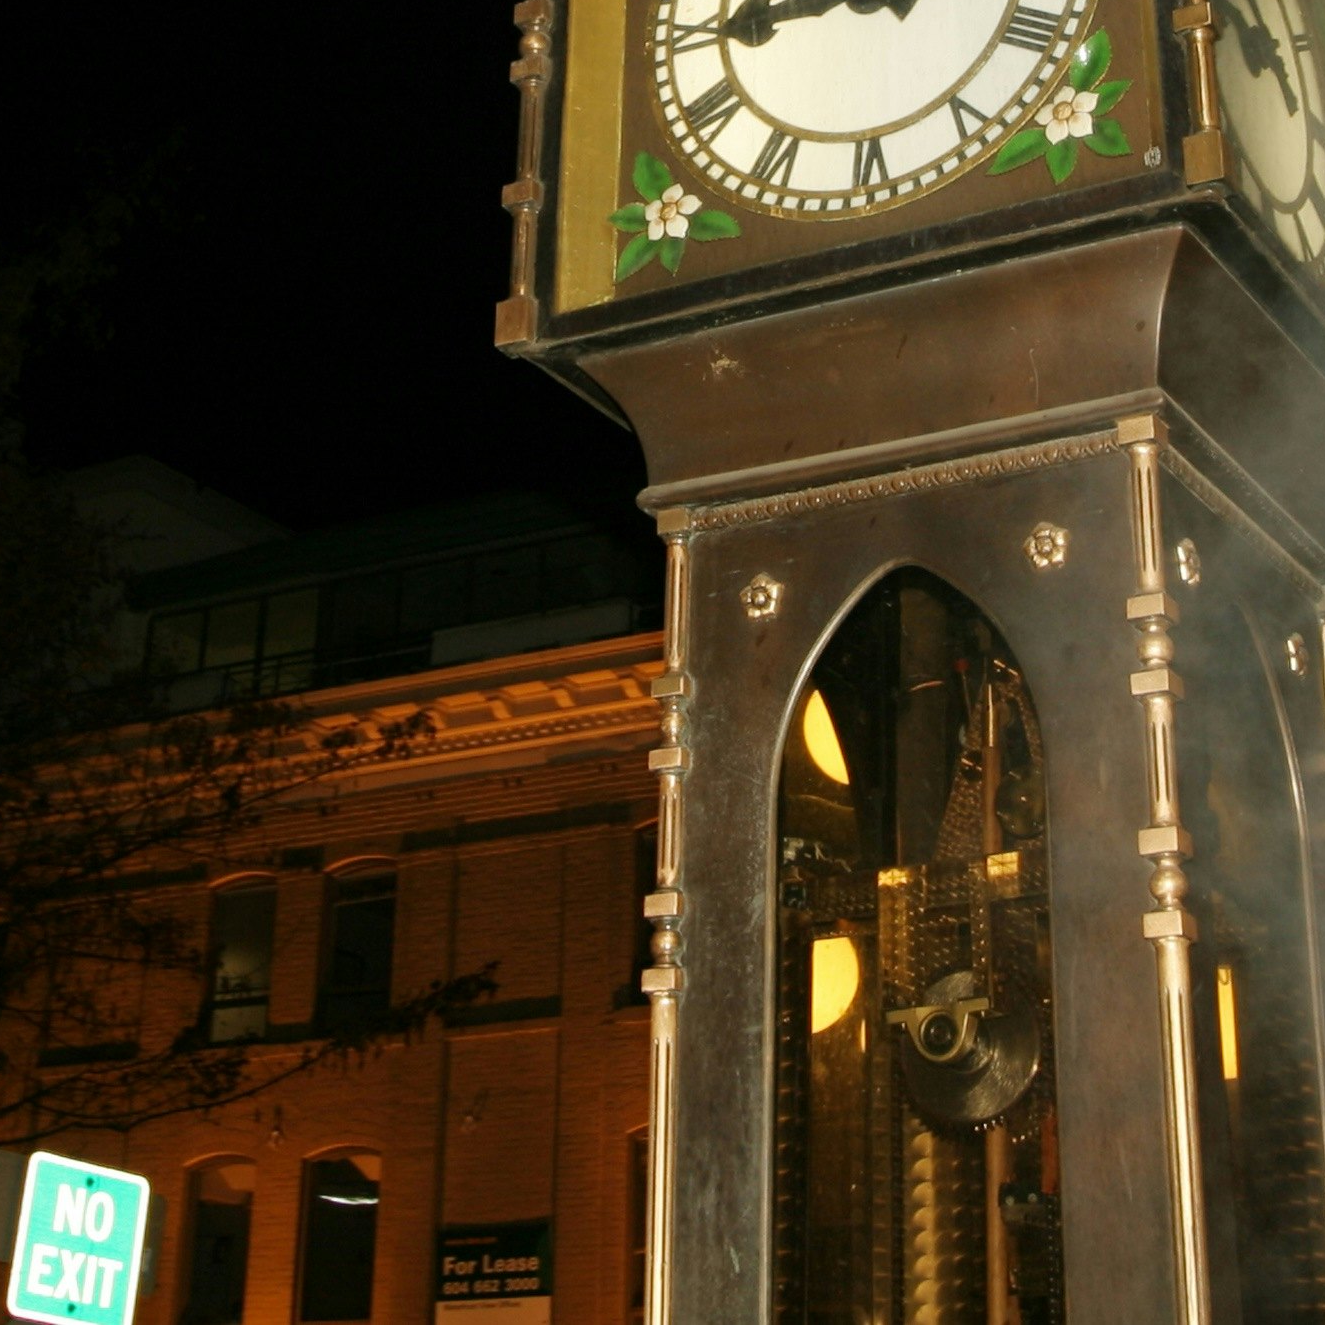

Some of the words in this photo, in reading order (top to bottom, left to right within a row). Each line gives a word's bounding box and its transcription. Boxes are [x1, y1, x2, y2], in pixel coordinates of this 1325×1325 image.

[52, 1183, 115, 1243] NO
[26, 1242, 124, 1309] EXIT
[443, 1256, 476, 1276] For
[482, 1254, 539, 1273] Lease
